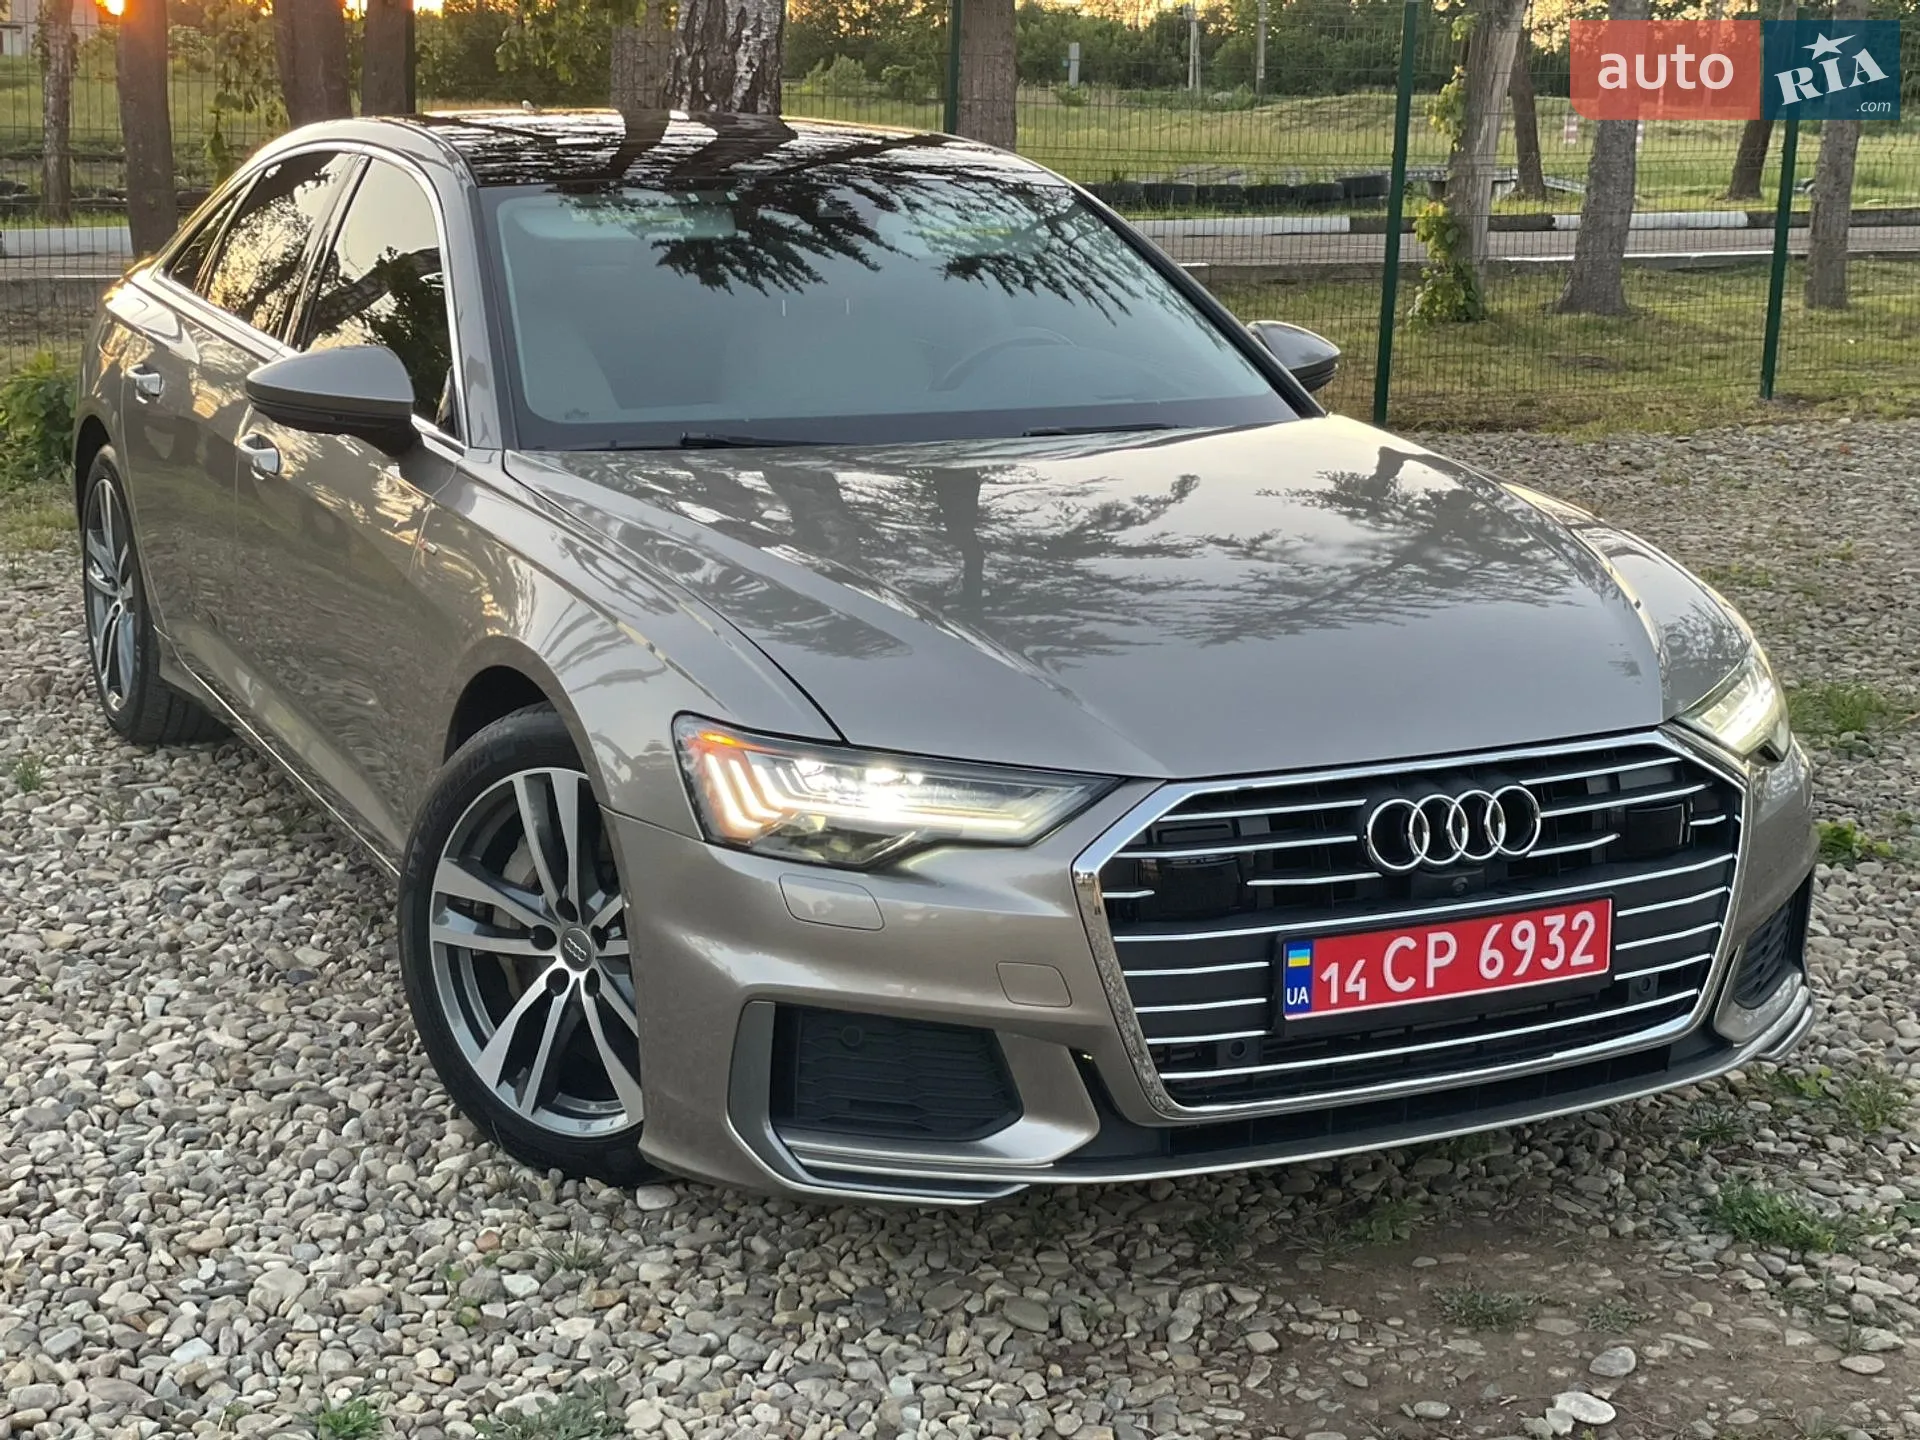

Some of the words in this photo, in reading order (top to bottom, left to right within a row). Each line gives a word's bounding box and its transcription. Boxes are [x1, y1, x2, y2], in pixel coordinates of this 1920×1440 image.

[1320, 958, 1367, 1004] 14
[1382, 931, 1458, 993] CP
[1478, 910, 1596, 980] 6932
[1286, 986, 1309, 1006] UA
